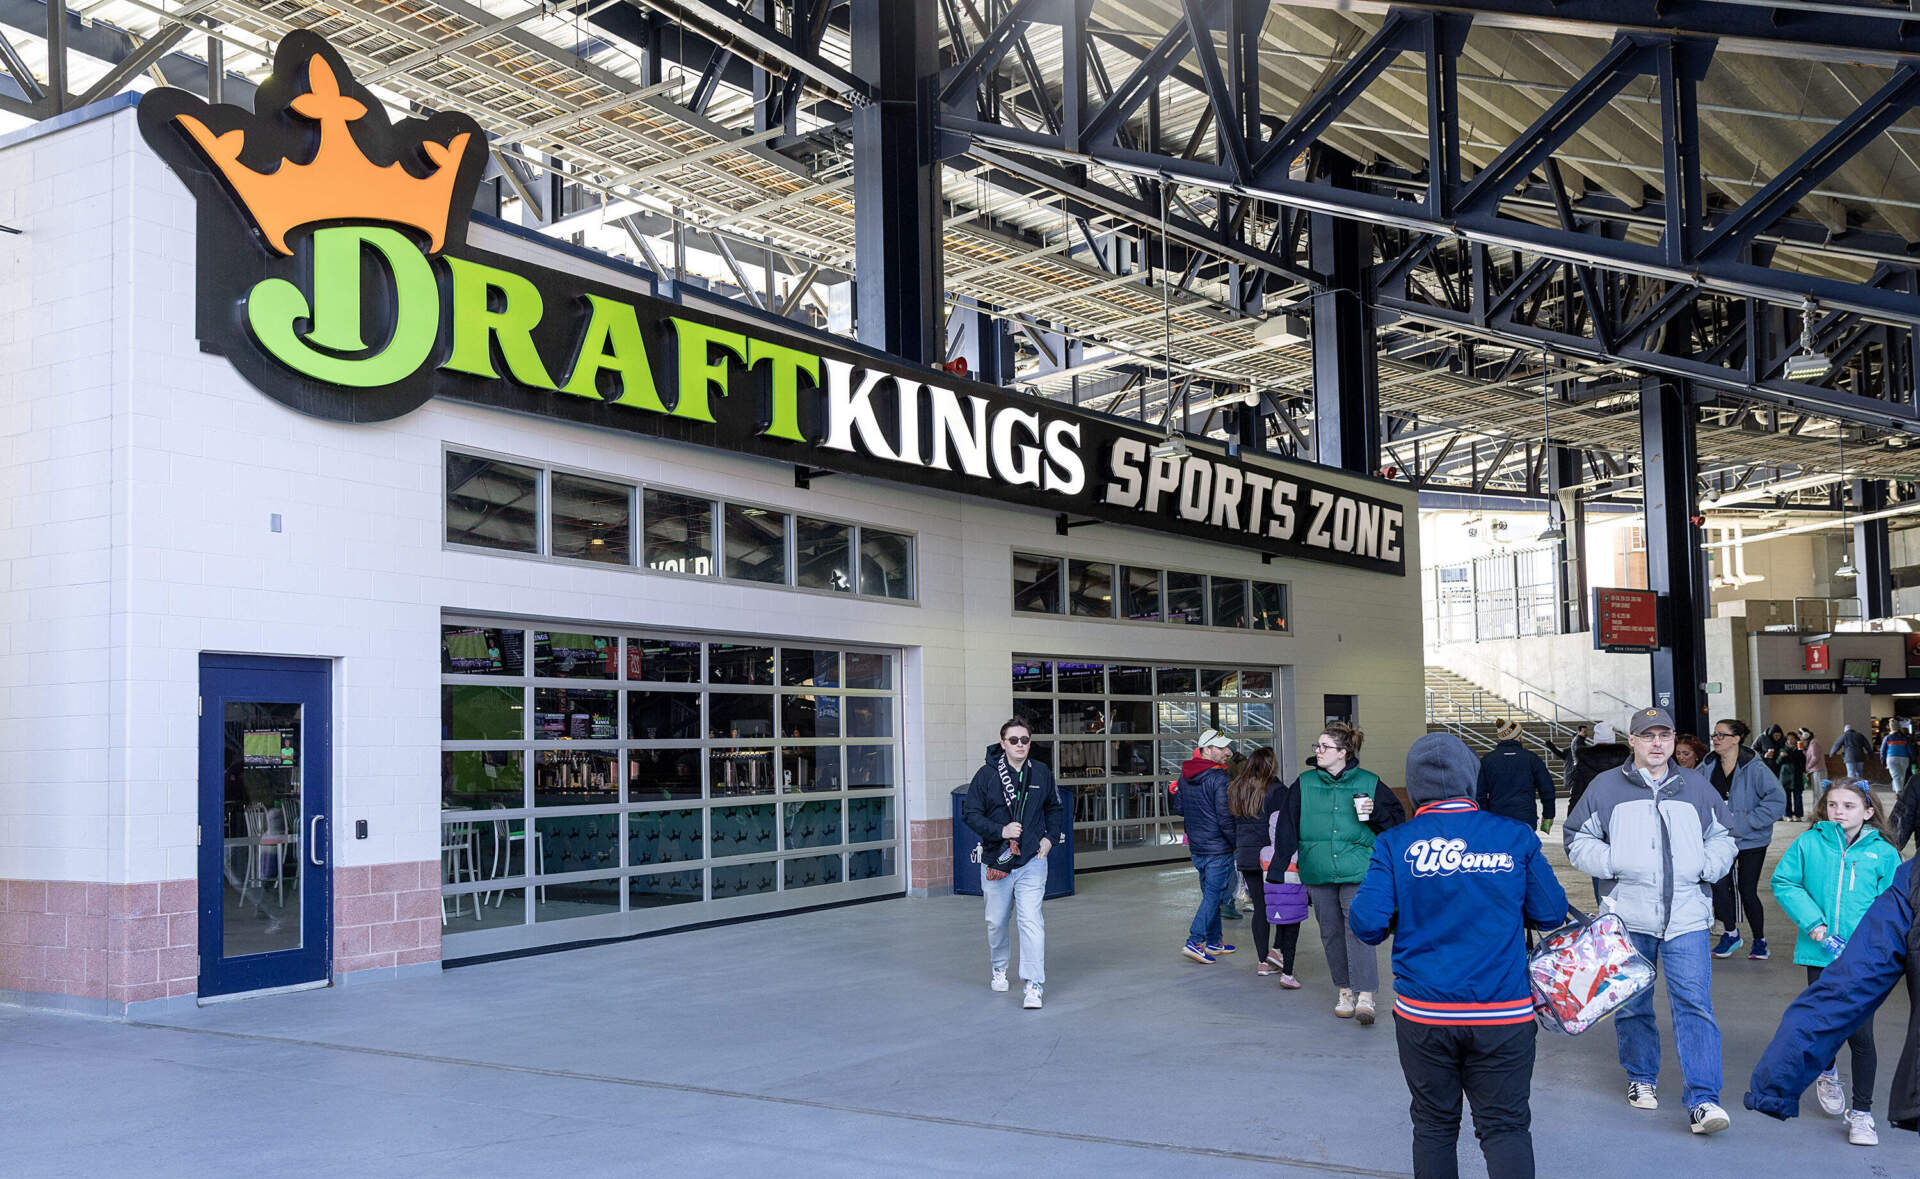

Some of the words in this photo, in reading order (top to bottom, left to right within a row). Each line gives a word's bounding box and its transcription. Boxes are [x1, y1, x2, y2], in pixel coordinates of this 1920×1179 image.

[1106, 437, 1298, 540] SPORTS
[1305, 492, 1403, 562] ZONE
[1405, 837, 1514, 877] UConn
